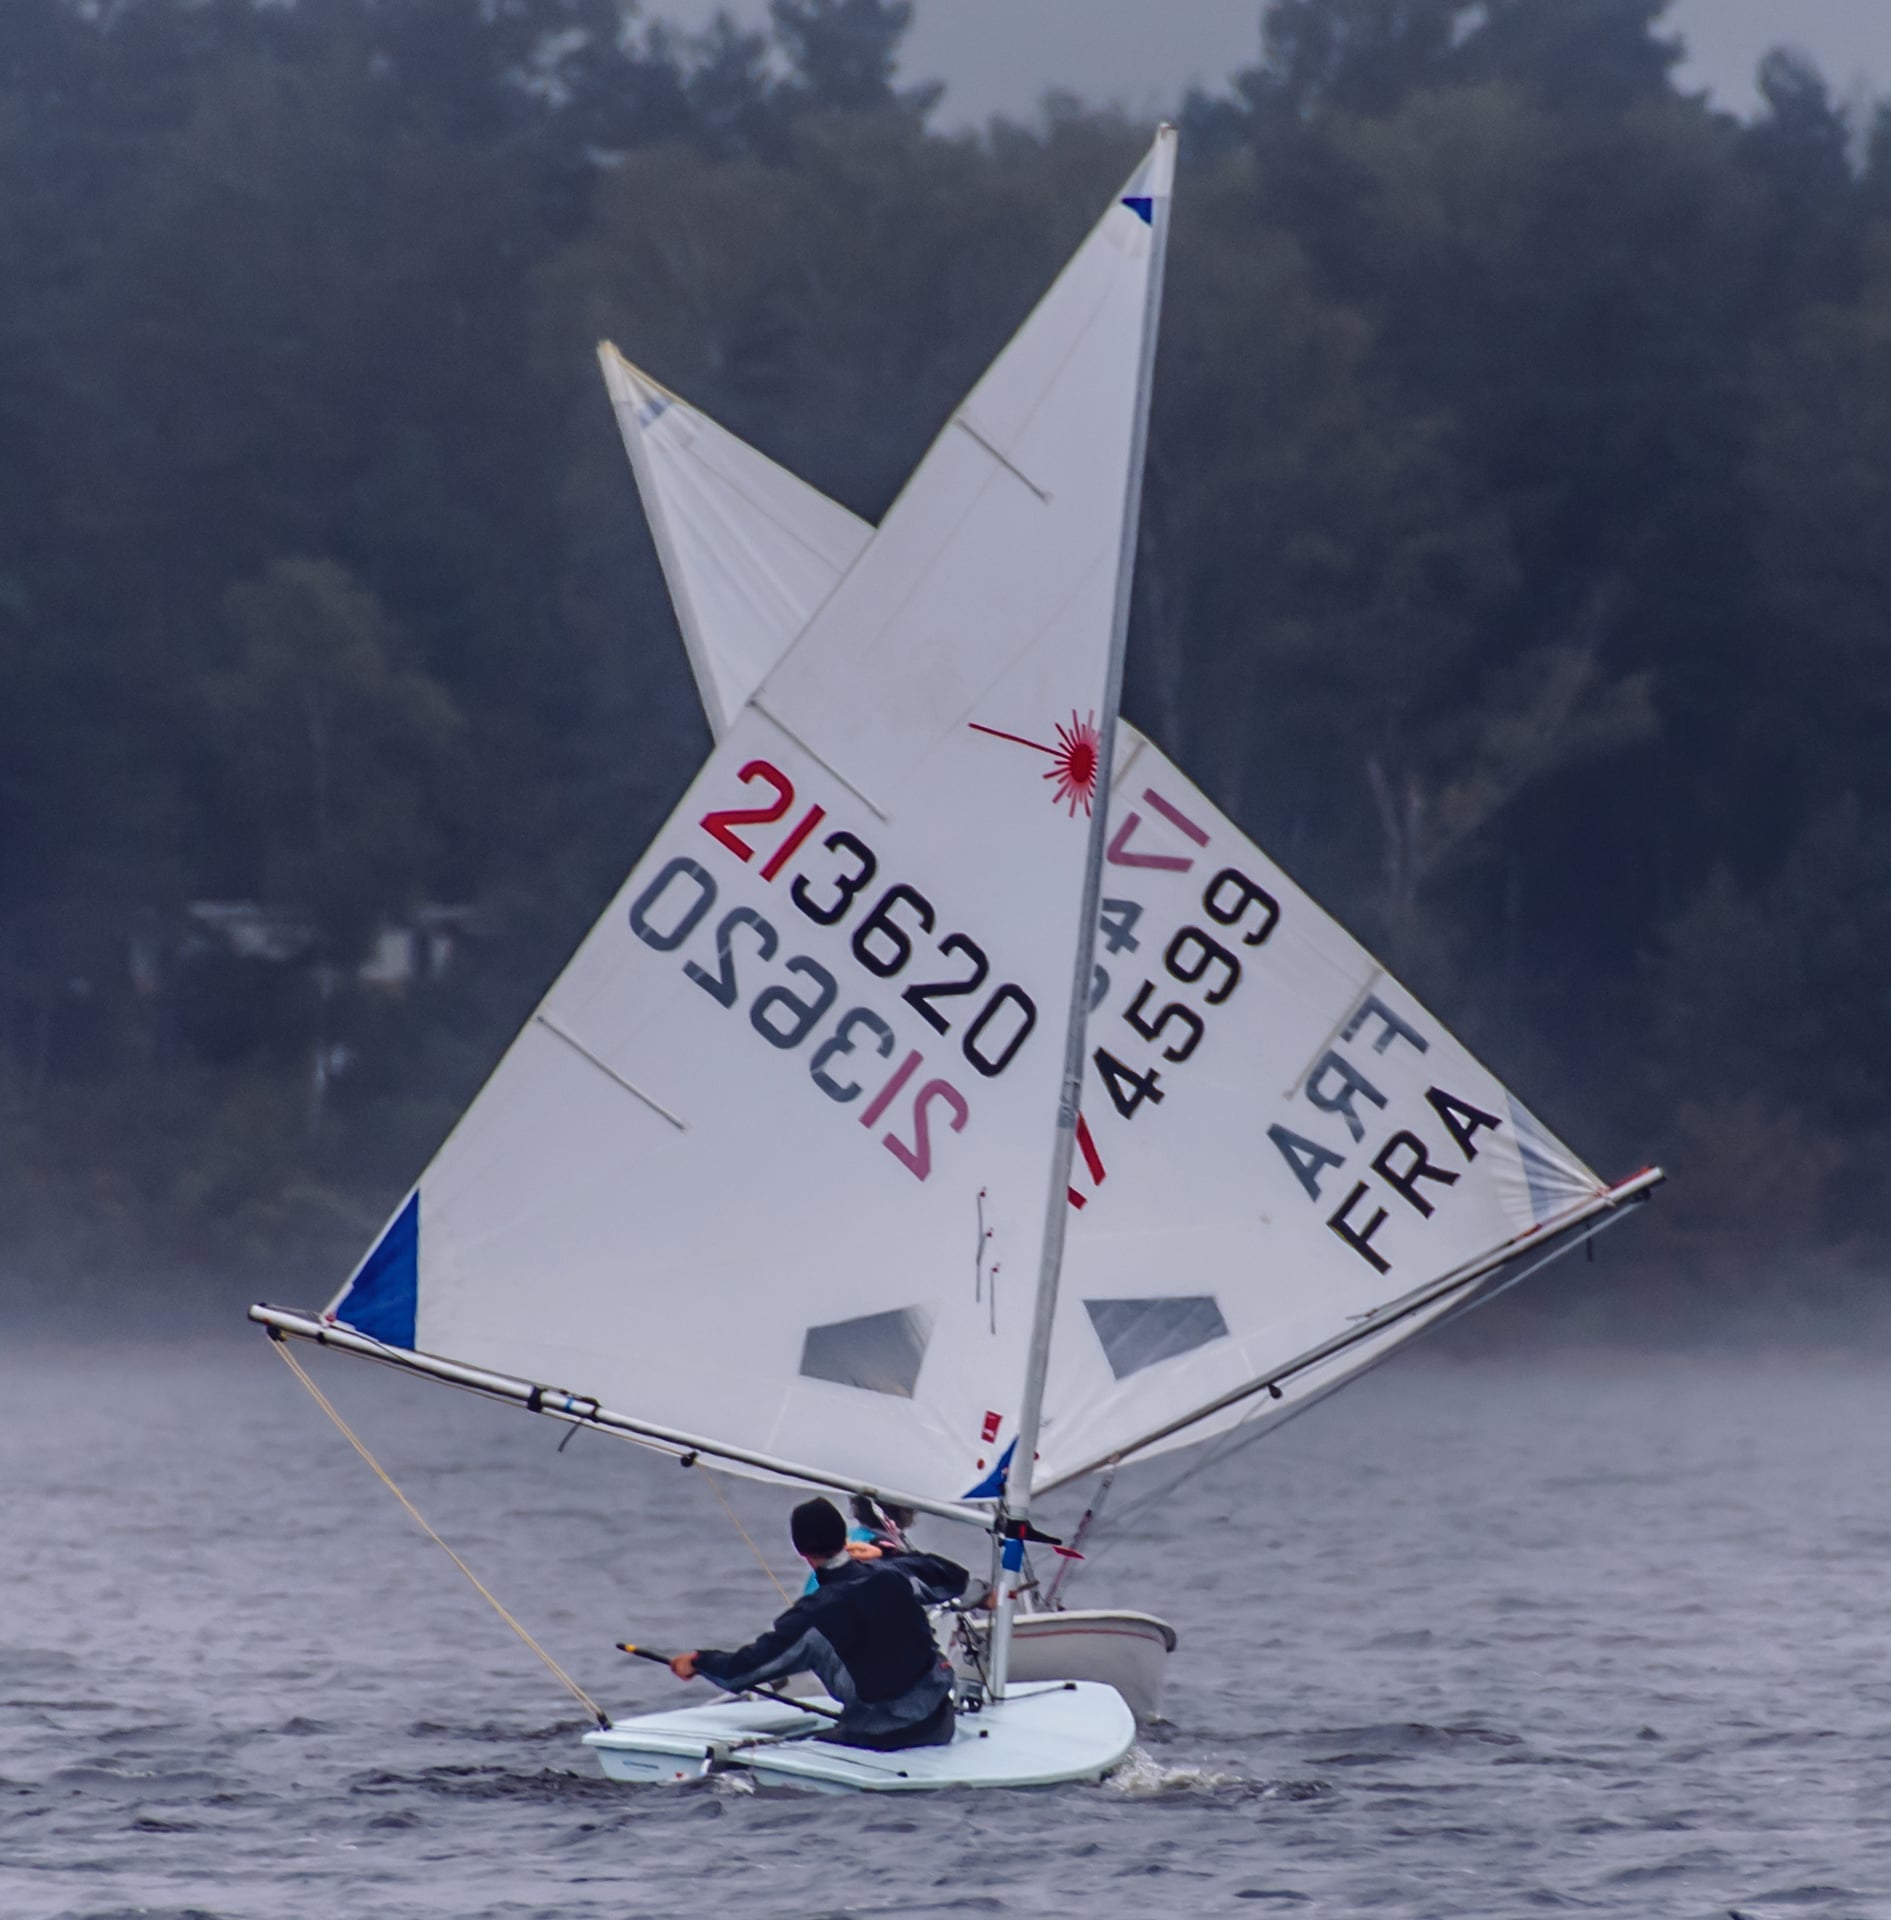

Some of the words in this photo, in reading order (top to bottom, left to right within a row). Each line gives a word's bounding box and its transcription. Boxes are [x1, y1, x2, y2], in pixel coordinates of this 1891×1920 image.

[700, 759, 1038, 1078] 213620
[1066, 866, 1281, 1211] 74599
[1325, 1085, 1504, 1275] FRA
